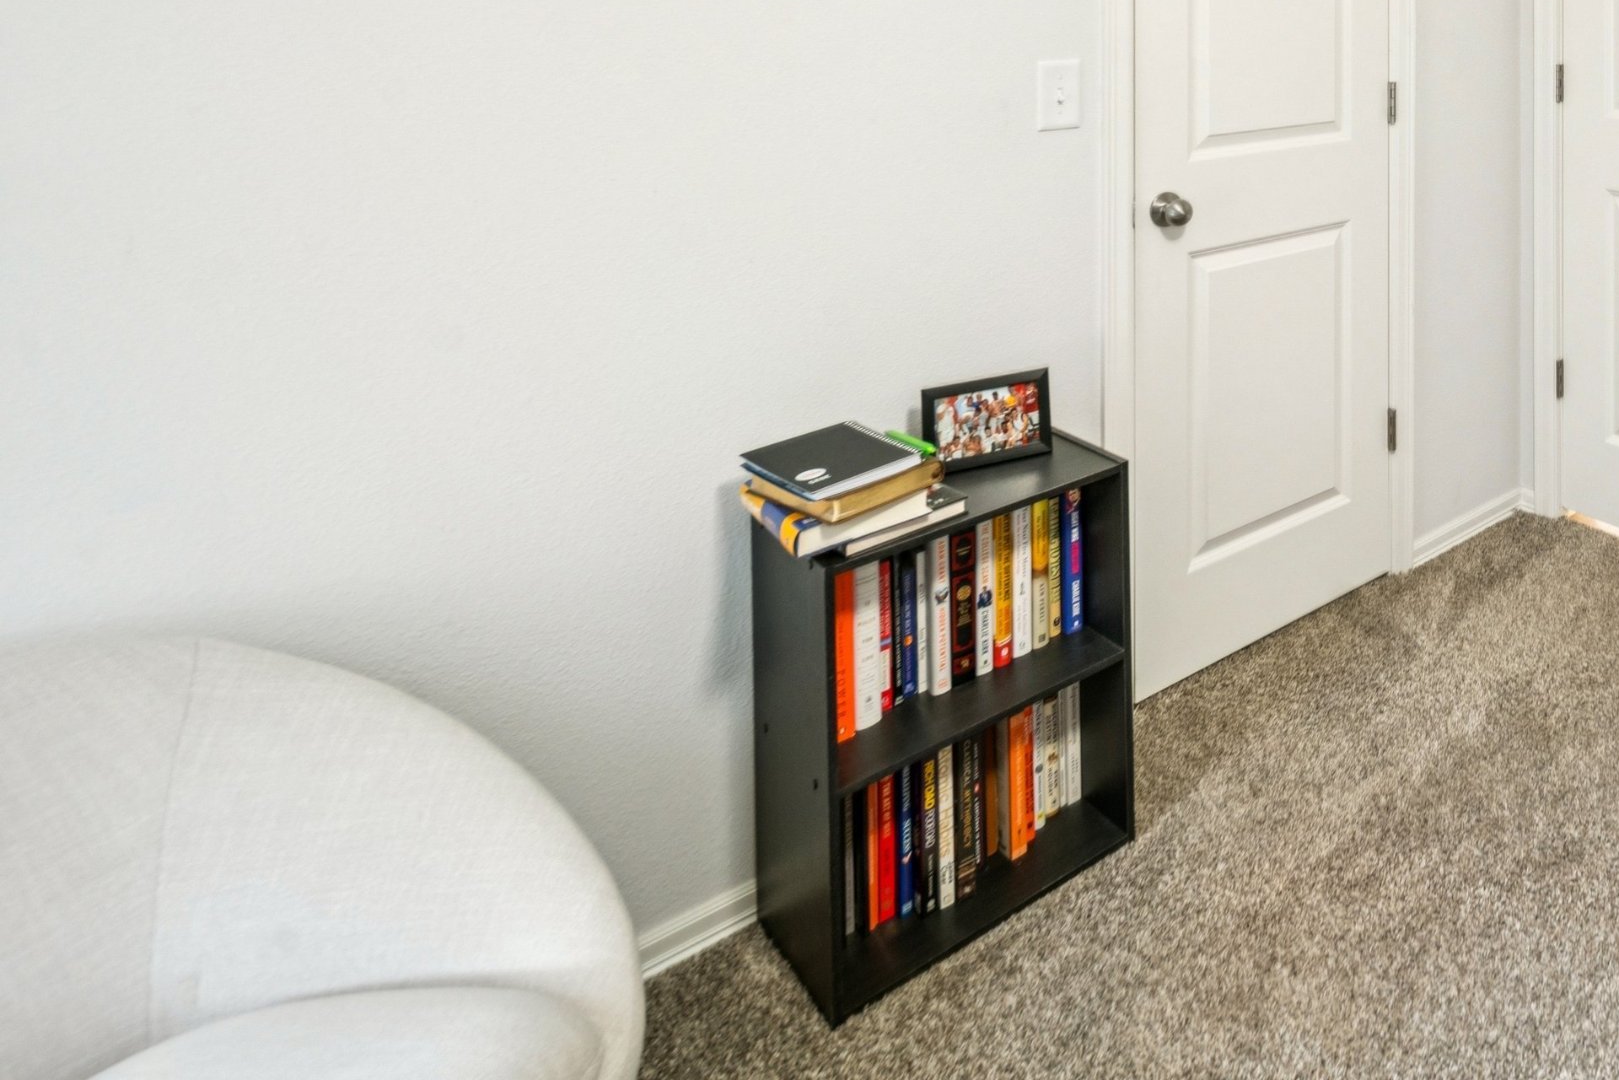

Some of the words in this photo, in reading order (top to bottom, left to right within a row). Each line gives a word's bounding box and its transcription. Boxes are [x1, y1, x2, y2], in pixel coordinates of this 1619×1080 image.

[981, 610, 989, 638] CHARLIE
[981, 638, 989, 656] KIRK
[924, 760, 936, 786] RICH
[924, 784, 936, 810] DAD
[963, 789, 972, 848] MYTHOLOGY
